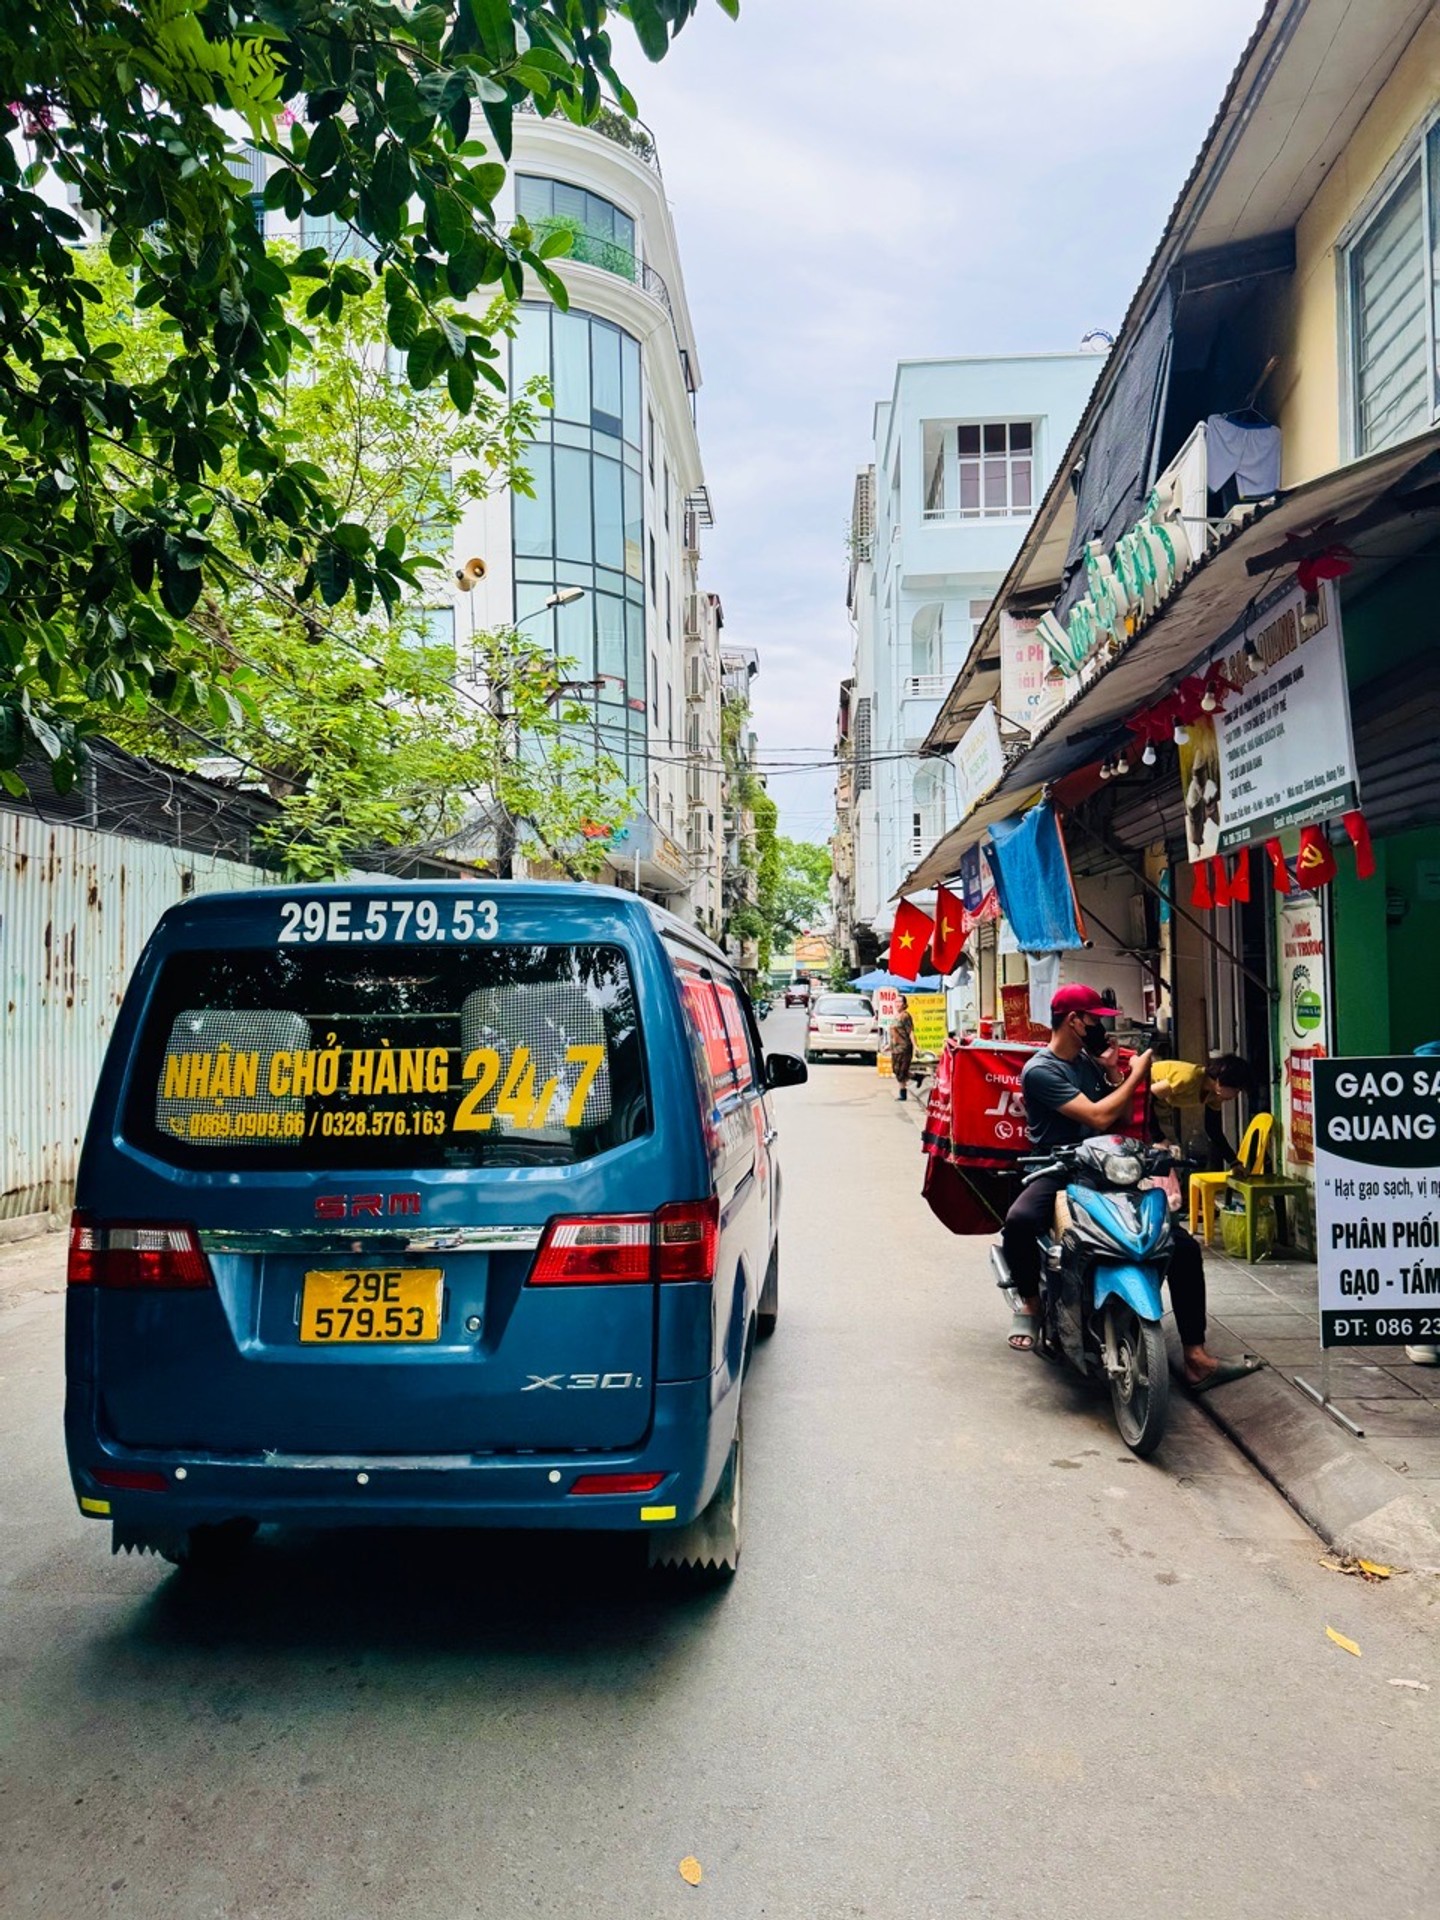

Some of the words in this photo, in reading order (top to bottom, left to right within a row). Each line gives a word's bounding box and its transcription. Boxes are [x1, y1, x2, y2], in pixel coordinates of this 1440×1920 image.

[277, 899, 499, 943] 29E.579.53
[164, 1041, 259, 1107] NHẬN
[268, 1031, 343, 1097] CHỞ
[351, 1038, 449, 1095] HÀNG
[452, 1044, 605, 1131] 24/7
[1335, 1070, 1404, 1105] GẠO
[322, 1109, 446, 1136] 0328.576.163
[1327, 1113, 1437, 1142] QUANG
[1335, 1177, 1356, 1198] Hạt
[1359, 1180, 1380, 1201] gạo
[1383, 1177, 1414, 1200] sạch,
[1417, 1176, 1427, 1198] vị
[1431, 1181, 1440, 1198] n
[315, 1192, 422, 1220] SRM
[1332, 1216, 1386, 1249] PHÂN
[1393, 1212, 1439, 1248] PHỐI
[342, 1272, 402, 1303] 29E
[1340, 1268, 1380, 1301] GẠO
[1399, 1258, 1440, 1295] TẤM
[315, 1306, 424, 1338] 579.53
[1333, 1318, 1369, 1338] ĐT:
[1375, 1317, 1413, 1336] 086
